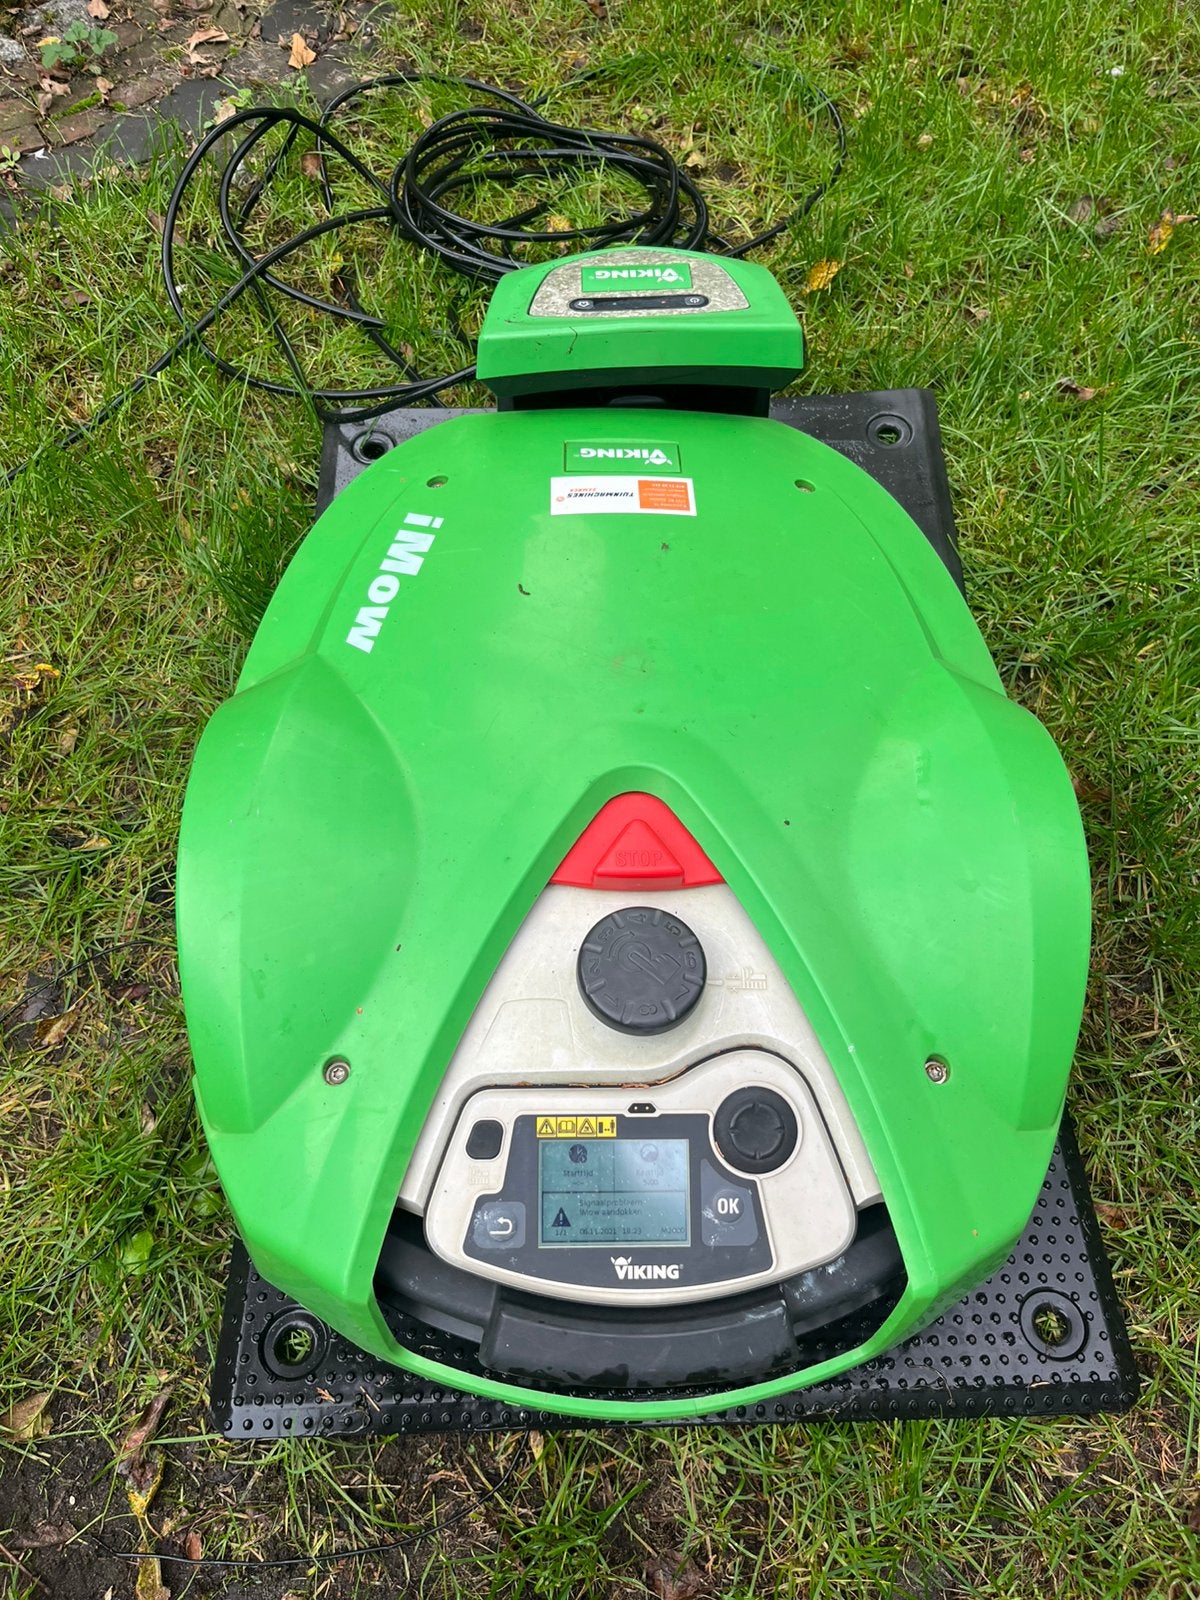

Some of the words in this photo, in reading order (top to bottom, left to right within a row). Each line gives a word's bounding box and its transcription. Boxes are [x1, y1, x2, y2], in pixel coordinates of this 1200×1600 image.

[594, 267, 679, 280] VIKING
[580, 447, 667, 460] VIKING
[346, 512, 444, 654] iMow
[616, 851, 663, 867] STOP
[717, 1197, 740, 1215] OK
[615, 1264, 680, 1280] VIKING
